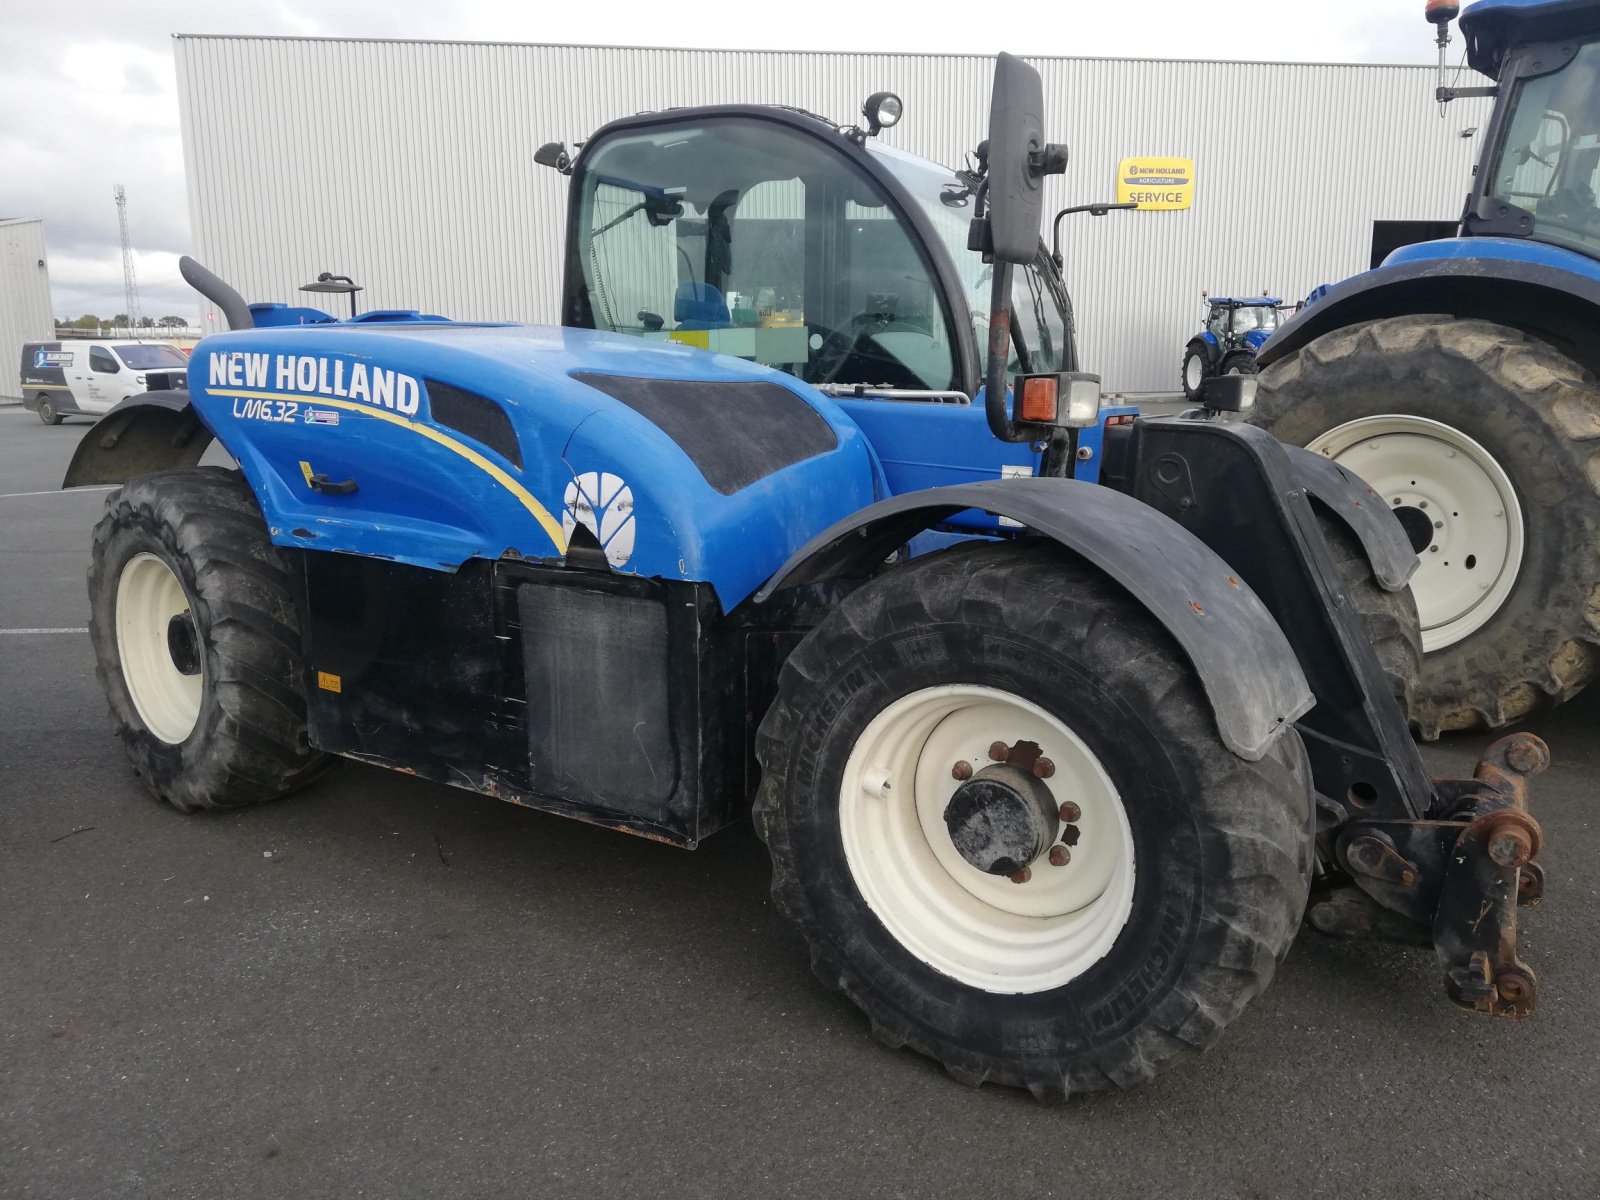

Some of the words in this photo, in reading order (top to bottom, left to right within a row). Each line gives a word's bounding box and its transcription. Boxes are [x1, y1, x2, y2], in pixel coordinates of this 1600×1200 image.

[1129, 192, 1183, 202] SERVICE
[209, 352, 269, 388] NEW
[276, 354, 420, 416] HOLLAND
[232, 398, 298, 422] LM6.32
[795, 666, 875, 788] MICHELIN
[1085, 904, 1187, 1034] MICHELIN
